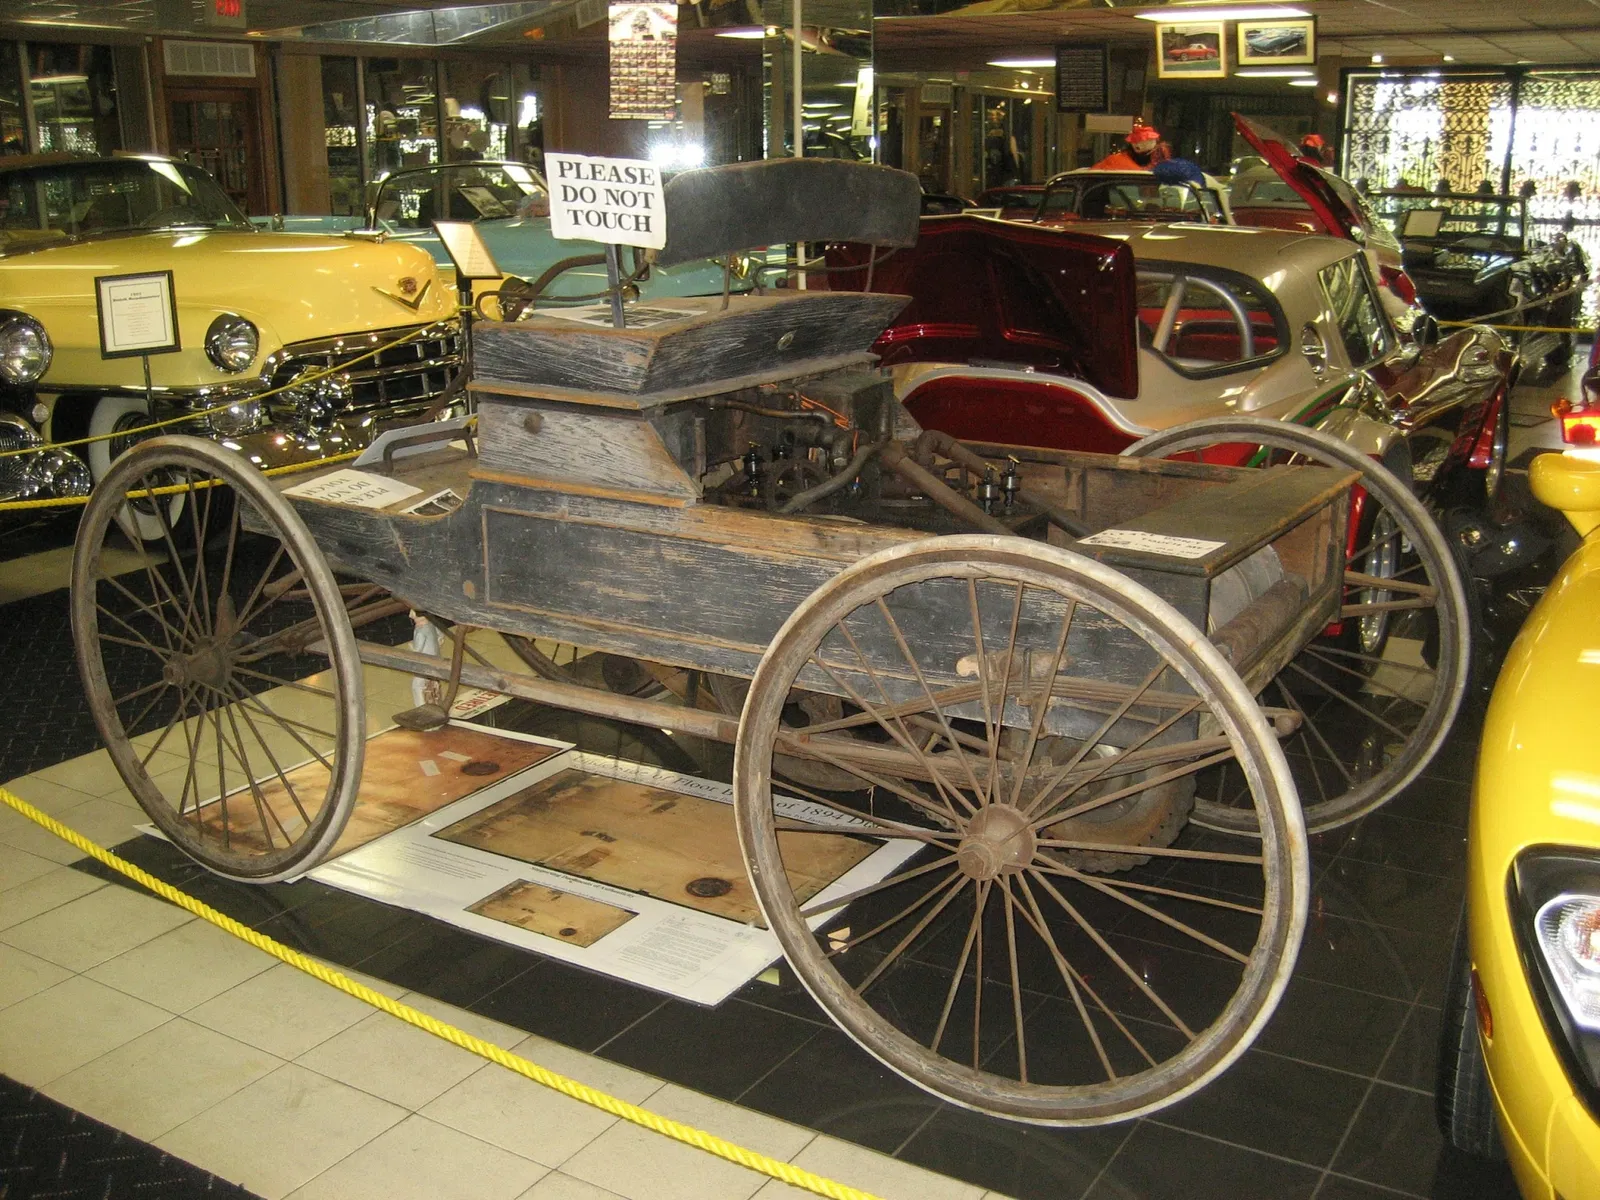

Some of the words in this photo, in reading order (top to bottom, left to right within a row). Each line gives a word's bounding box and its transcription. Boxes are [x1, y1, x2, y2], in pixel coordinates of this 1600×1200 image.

[557, 160, 655, 186] PLEASE
[561, 184, 597, 204] DO
[604, 188, 655, 209] NOT
[567, 209, 652, 233] TOUCH
[302, 477, 351, 496] TOUCH
[347, 480, 371, 491] DO
[652, 774, 675, 783] of
[672, 777, 719, 792] Floor
[776, 802, 801, 810] of
[802, 806, 845, 821] 1894
